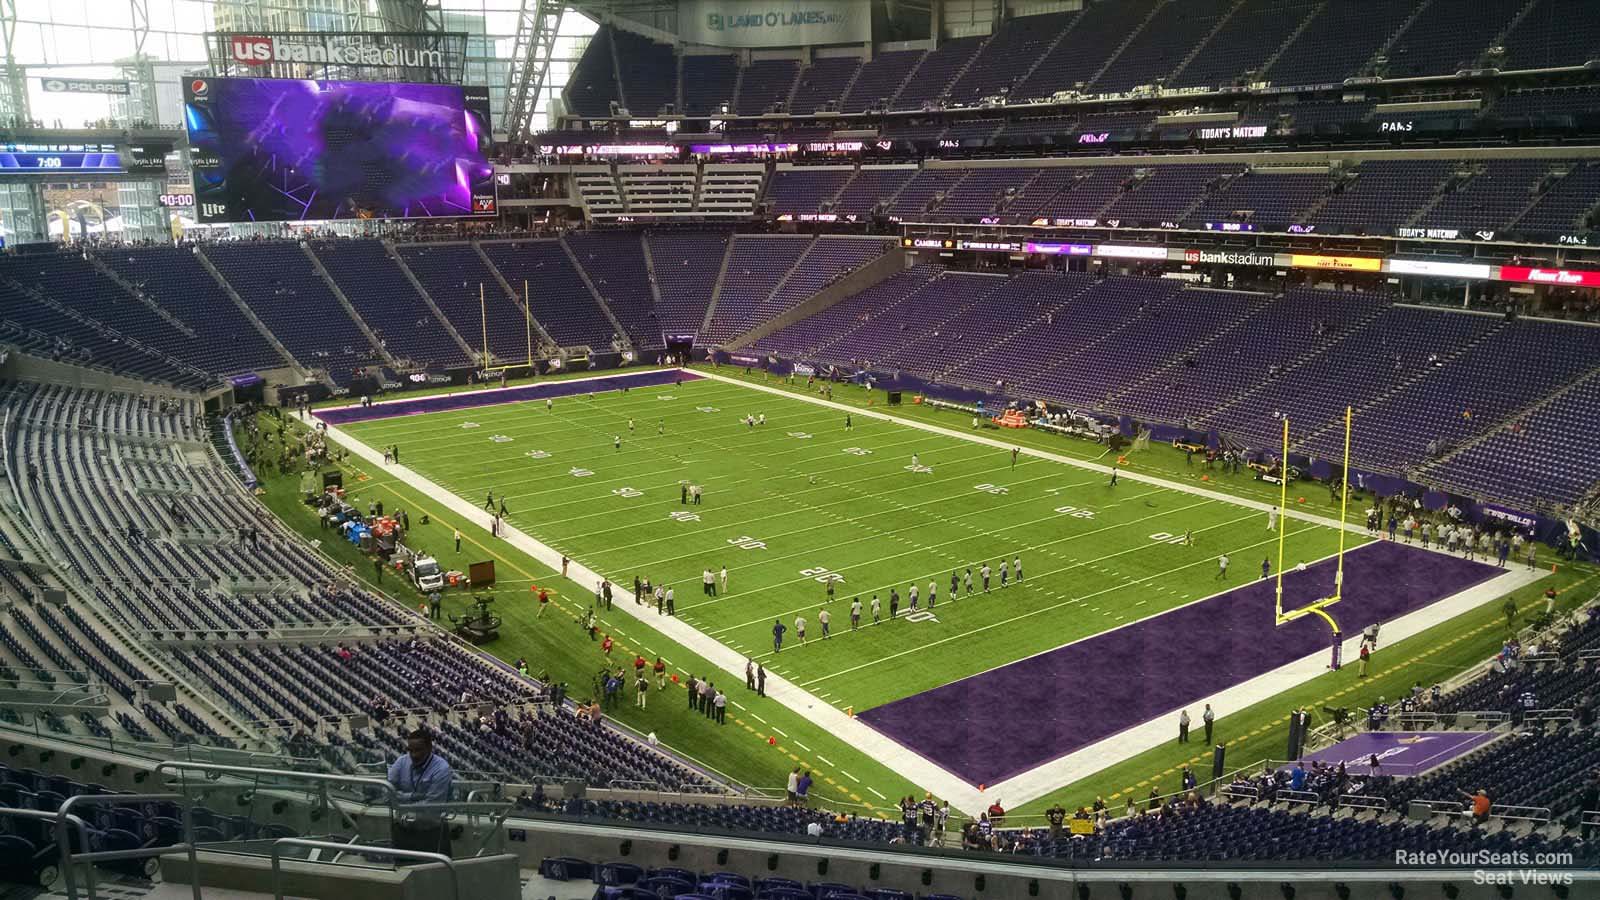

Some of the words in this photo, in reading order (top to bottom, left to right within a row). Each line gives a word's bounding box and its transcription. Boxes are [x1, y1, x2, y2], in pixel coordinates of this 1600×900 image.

[68, 82, 127, 93] POLARIS
[1201, 128, 1231, 139] TODAY'S
[1232, 126, 1268, 138] MATCHUP
[810, 142, 834, 152] TODAY'S
[836, 142, 862, 151] MATCHUP
[37, 157, 62, 169] 7:00
[160, 195, 192, 206] 90:00
[202, 203, 225, 218] Lite
[1399, 228, 1425, 238] TODAY'S
[1427, 229, 1458, 239] MATCHUP
